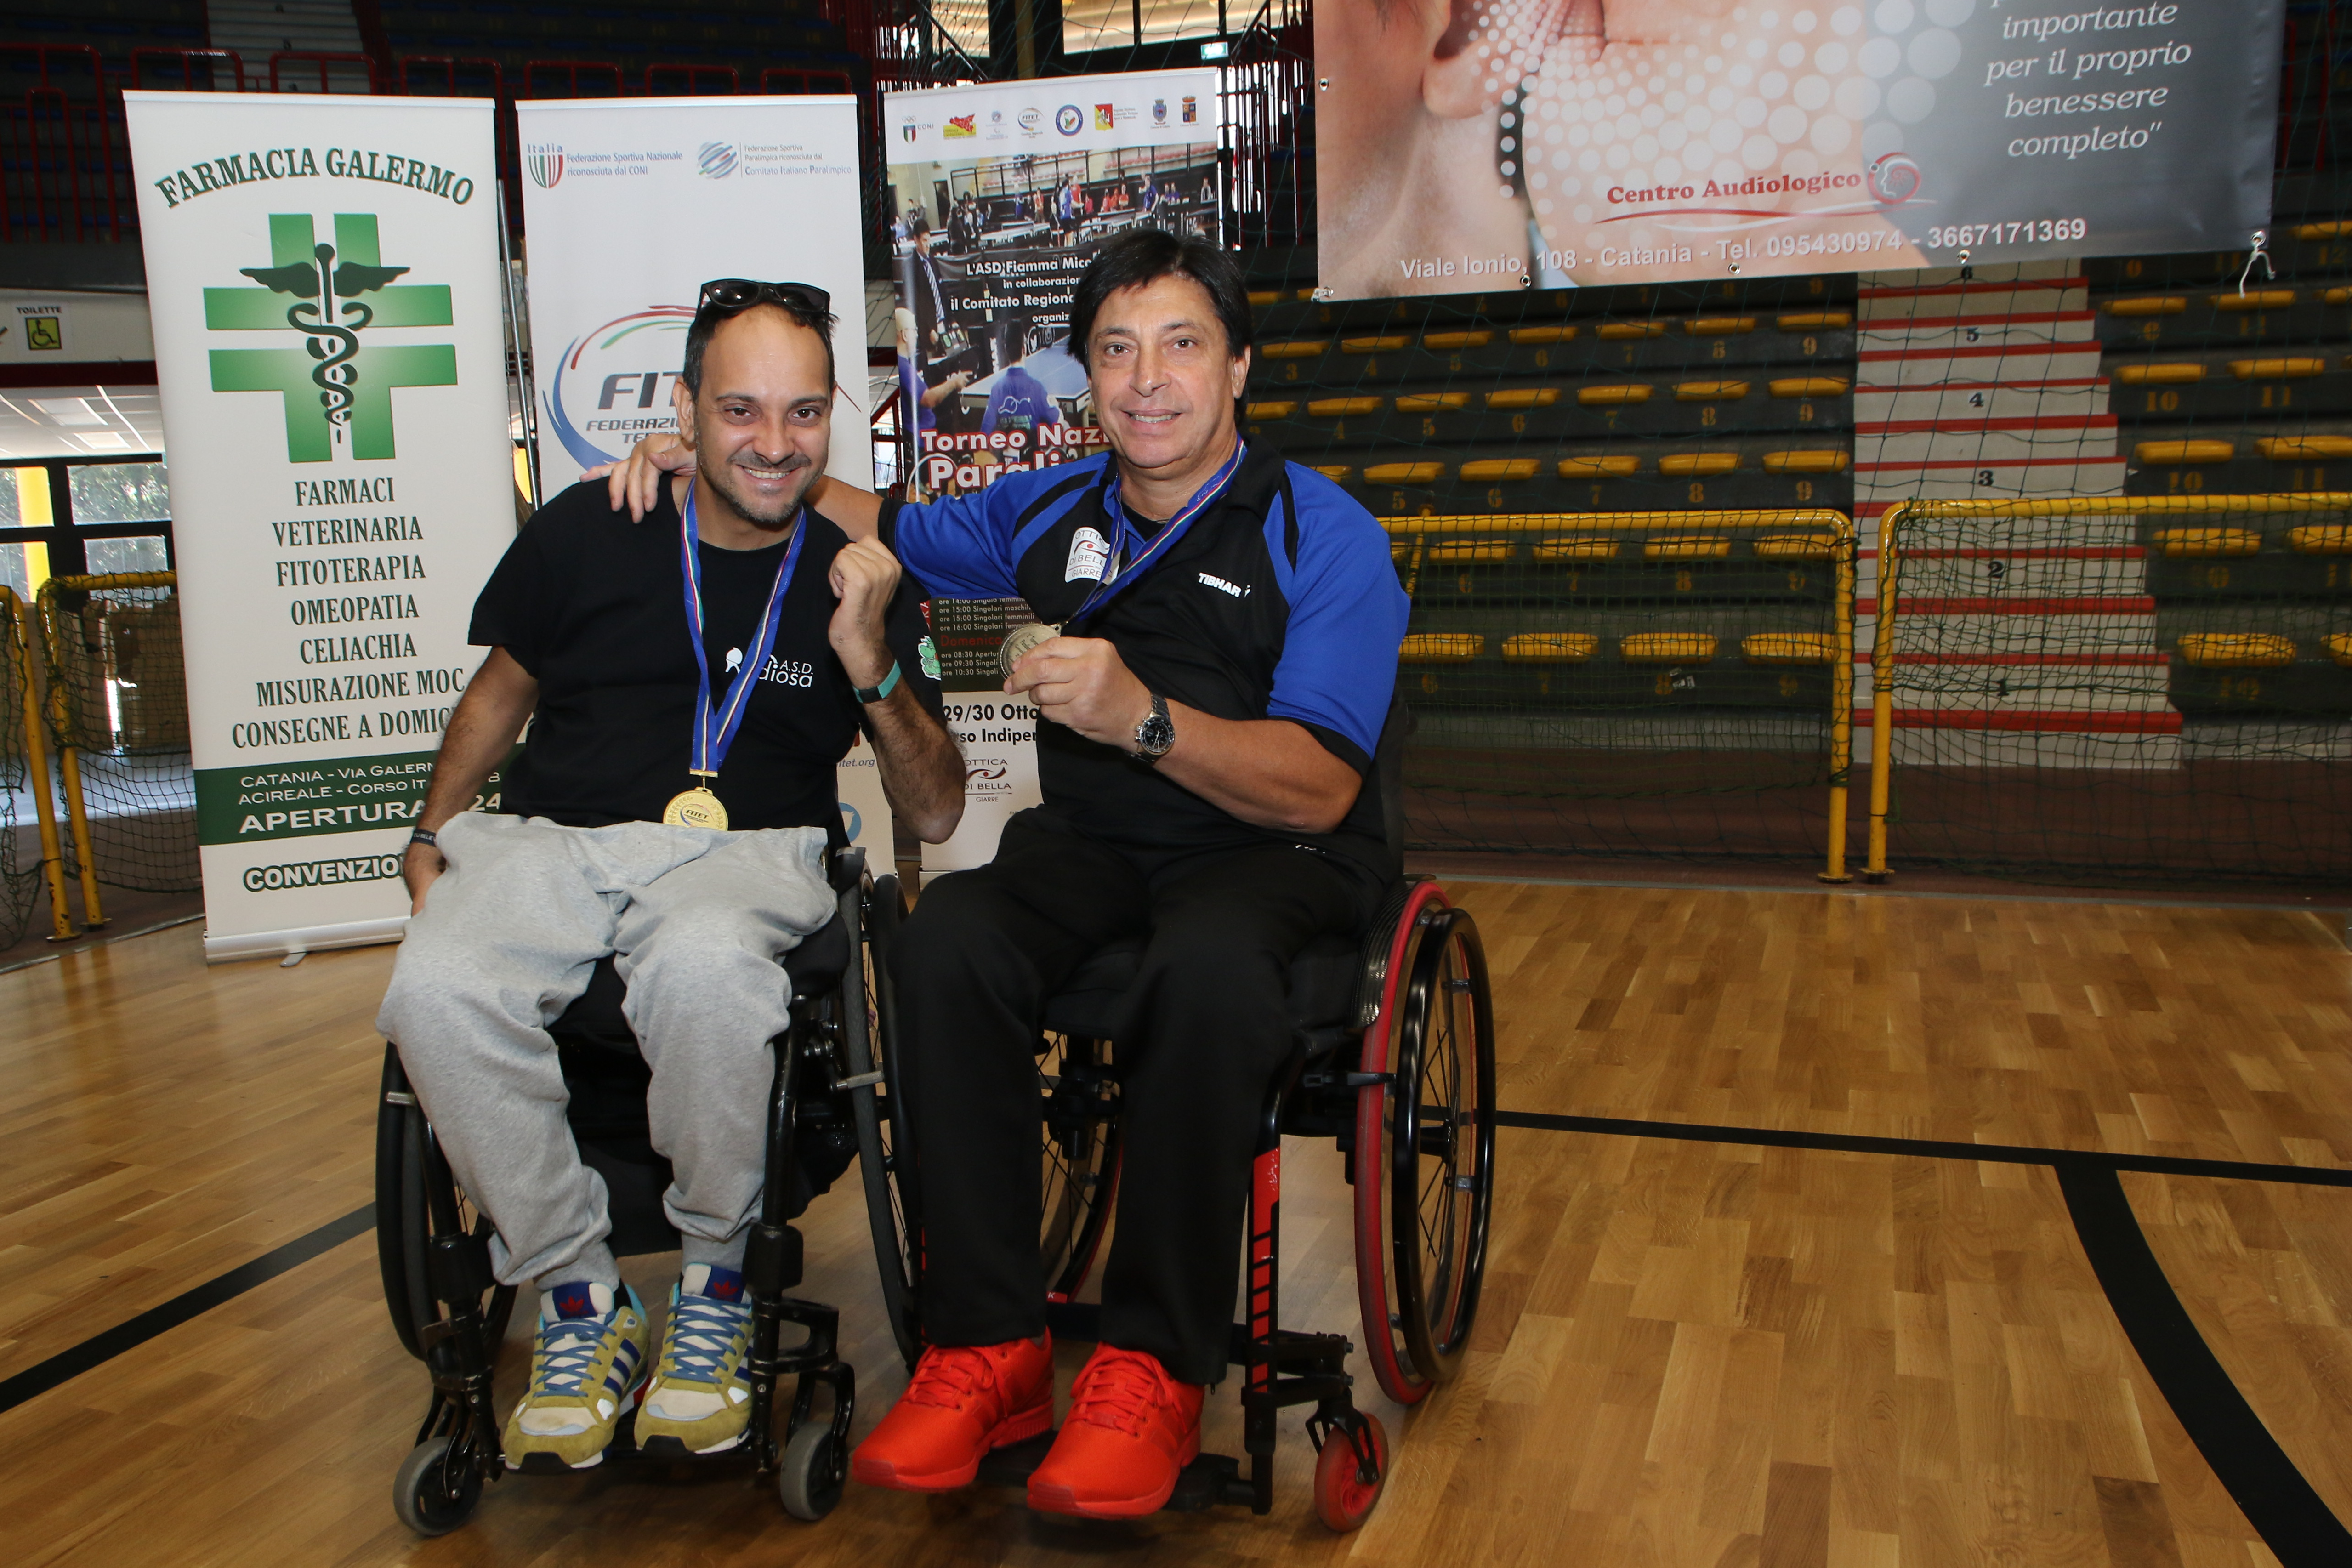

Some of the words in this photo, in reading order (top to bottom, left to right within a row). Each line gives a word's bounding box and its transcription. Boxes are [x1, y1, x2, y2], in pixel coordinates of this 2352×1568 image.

[2003, 1, 2178, 42] importante
[1983, 57, 2039, 87] per
[2048, 48, 2067, 75] il
[2072, 40, 2192, 80] proprio
[2005, 86, 2169, 118] benessere
[528, 142, 563, 153] Italia
[567, 152, 612, 164] Federazione
[614, 151, 644, 164] Sportiva
[646, 150, 683, 162] Nazionale
[744, 144, 779, 153] Federazione
[780, 143, 803, 153] Sportiva
[744, 153, 778, 163] Paralimpica
[779, 153, 813, 161] riconosciuta
[154, 147, 320, 209] FARMACIA
[325, 148, 474, 205] GALERMO
[568, 166, 613, 177] riconosciuta
[615, 165, 627, 176] dal
[629, 165, 648, 176] CONI
[744, 166, 778, 176] Comitato
[780, 165, 808, 176] Italiano
[809, 165, 852, 176] Paralimpico
[1607, 184, 1694, 204] Centro
[1702, 170, 1862, 198] Audiologico
[1401, 256, 1456, 279] Viale
[1464, 252, 1528, 276] Ionio,
[1536, 250, 1577, 271] 108
[1601, 243, 1693, 267] Catania
[1716, 237, 1759, 261] Tel.
[1766, 229, 1903, 257] 095430974
[1927, 217, 2088, 250] 3667171369
[966, 260, 1003, 276] L'ASD
[1006, 260, 1058, 274] Fiamma
[1003, 279, 1012, 289] in
[16, 305, 62, 314] TOILETTE
[951, 296, 958, 311] il
[963, 295, 1020, 311] Comitato
[1032, 311, 1070, 324] organiz
[1966, 327, 1982, 342] 5
[1802, 336, 1818, 355] 9
[1286, 363, 1298, 380] 3
[1450, 354, 1462, 371] 5
[598, 372, 683, 410] FIT
[1969, 392, 1984, 408] 4
[2146, 390, 2179, 412] 10
[1701, 406, 1716, 426] 8
[1799, 403, 1814, 422] 9
[586, 416, 679, 431] FEDERAZI
[1423, 418, 1435, 436] 5
[920, 429, 1027, 452] Torneo
[1038, 423, 1110, 447] Naz
[1978, 470, 1994, 487] 3
[295, 477, 395, 506] FARMACI
[1392, 491, 1406, 510] 5
[1487, 488, 1503, 507] 6
[1589, 485, 1602, 505] 7
[1688, 483, 1704, 503] 8
[1795, 481, 1813, 501] 9
[272, 515, 424, 547] VETERINARIA
[1075, 530, 1108, 549] OTTIC
[276, 554, 426, 586] FITOTERAPIA
[1069, 557, 1076, 566] DI
[1078, 554, 1105, 568] BELL
[1987, 561, 2005, 579] 2
[1072, 568, 1102, 578] GIARRE
[1199, 572, 1242, 598] TIBHAR
[290, 594, 420, 625] OMEOPATIA
[973, 604, 1002, 613] Singolari
[973, 613, 1002, 622] Singolari
[974, 622, 1003, 631] Singolari
[300, 633, 417, 664] CELIACHIA
[940, 635, 1002, 647] Domenica
[975, 651, 999, 659] Apertur
[976, 659, 998, 669] Singoli
[758, 661, 812, 687] diosa
[780, 660, 813, 675] A.S.D.
[976, 668, 998, 676] Singoli
[256, 671, 410, 707] MISURAZIONE
[417, 668, 466, 693] MOC
[943, 704, 994, 724] 29/30
[1001, 704, 1038, 720] Otto
[232, 715, 351, 748] CONSEGNE
[358, 713, 374, 738] A
[378, 707, 456, 736] DOMIC
[959, 733, 977, 743] so
[240, 770, 324, 788] CATANIA
[338, 766, 366, 780] VIA
[238, 786, 333, 805] ACIREALE
[347, 780, 408, 795] CORSO
[412, 778, 427, 790] IT
[239, 799, 426, 834] APERTURA
[467, 792, 501, 812] 24
[686, 809, 709, 819] FITET
[243, 853, 403, 892] CONVENZIO
